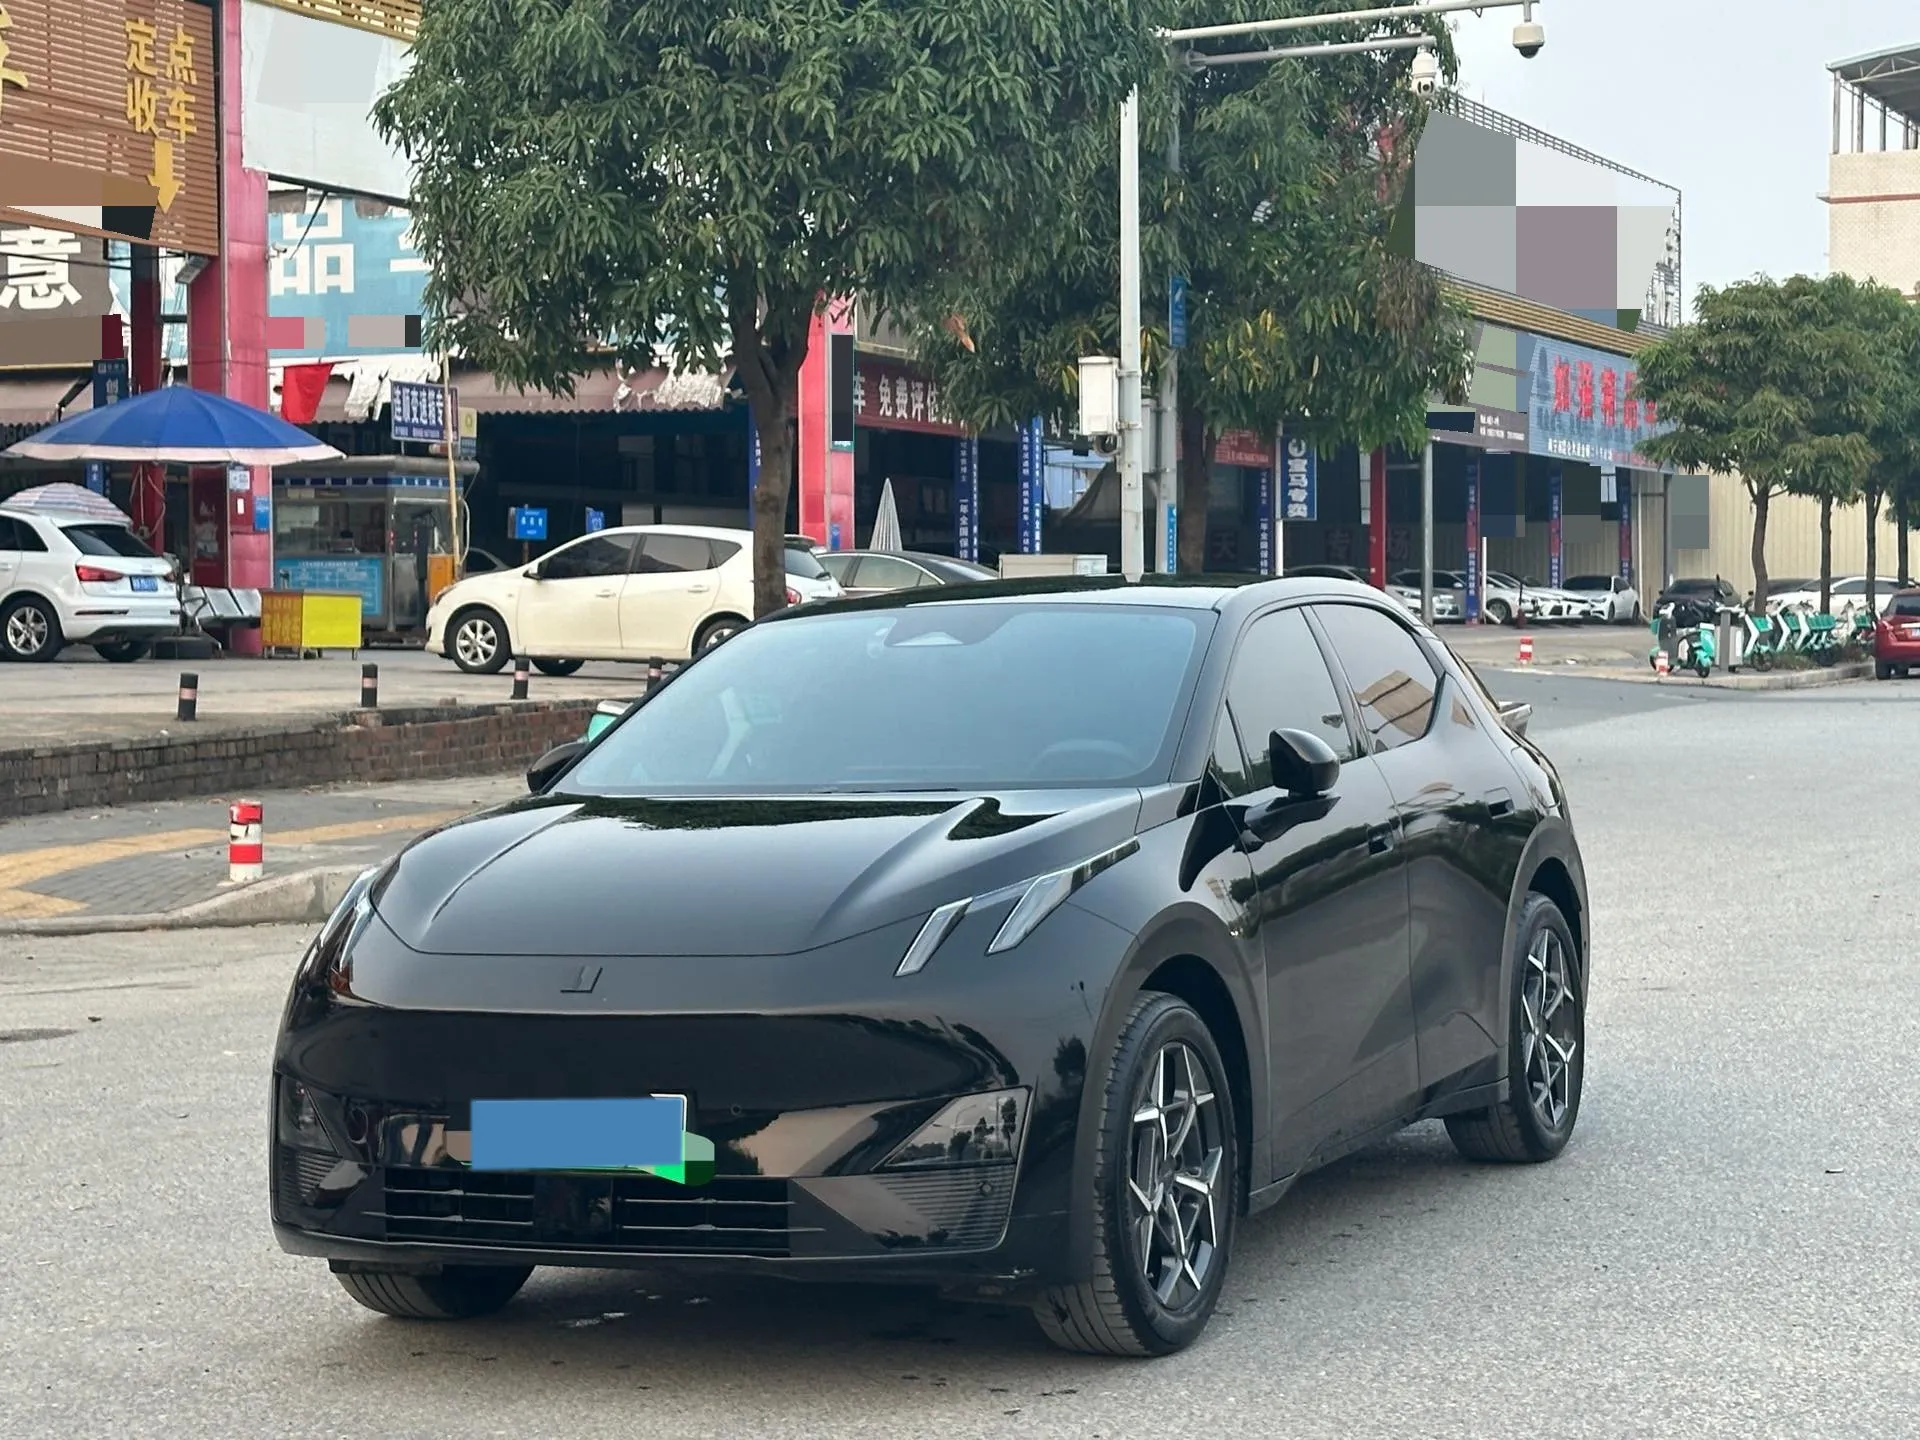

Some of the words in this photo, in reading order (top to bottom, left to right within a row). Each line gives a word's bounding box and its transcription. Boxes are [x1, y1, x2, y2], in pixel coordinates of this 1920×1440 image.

[126, 17, 197, 85] 定点
[126, 77, 197, 144] 收车
[0, 225, 82, 310] 意
[879, 373, 952, 424] 免费评估
